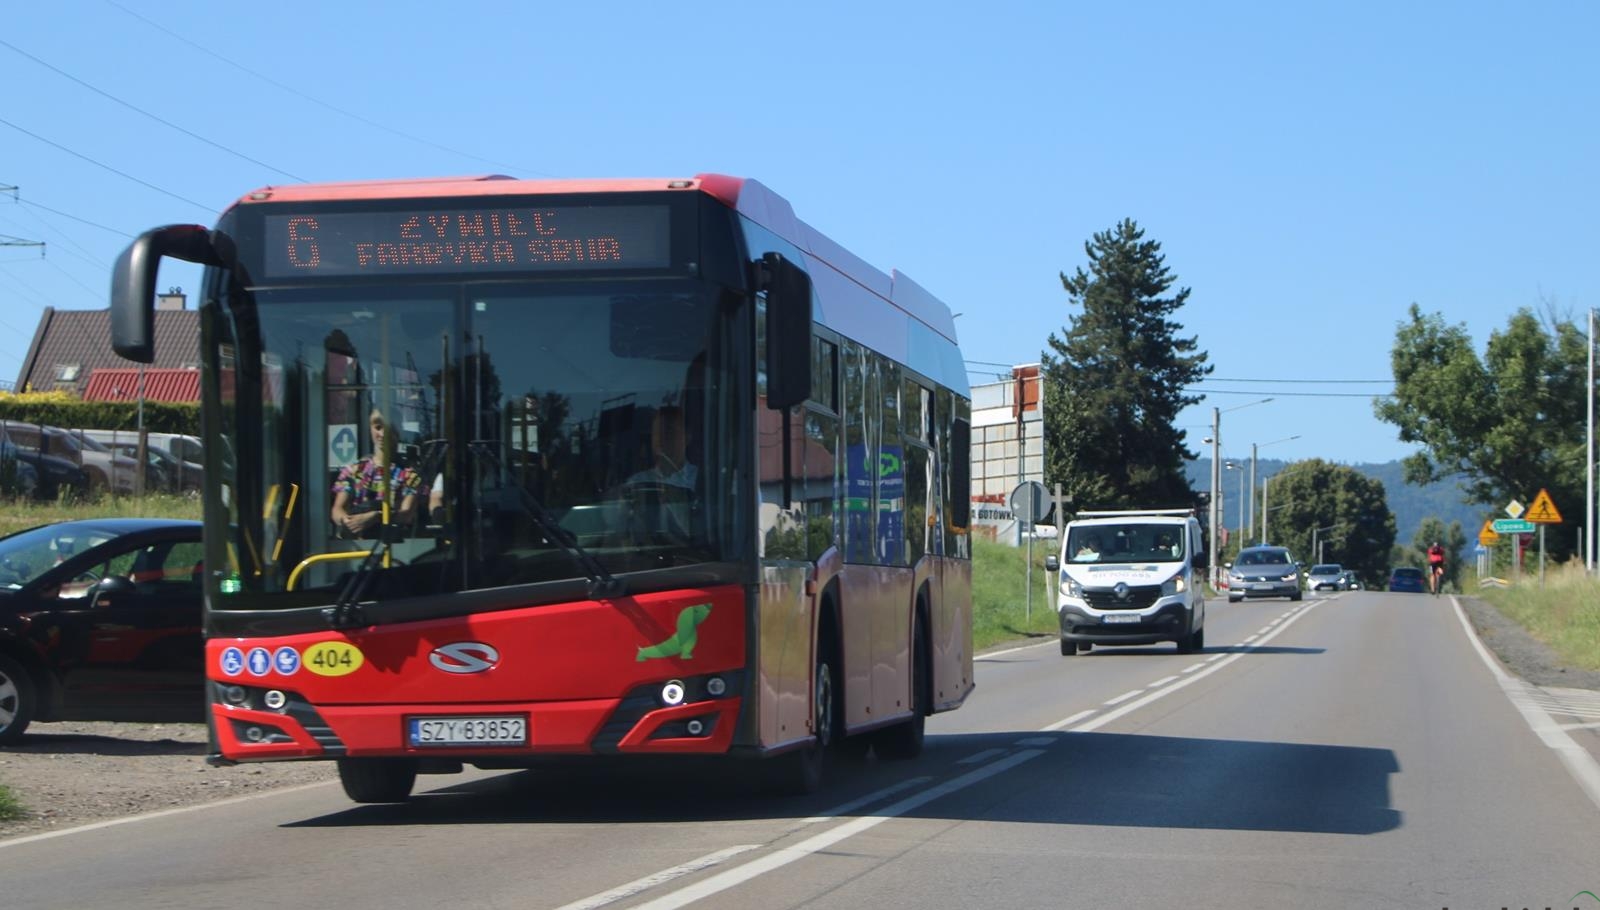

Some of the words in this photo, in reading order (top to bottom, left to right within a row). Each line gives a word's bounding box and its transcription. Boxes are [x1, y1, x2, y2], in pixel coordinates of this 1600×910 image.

[287, 215, 320, 268] 6
[312, 648, 352, 668] 404
[422, 721, 457, 741] SZY
[464, 719, 523, 740] 83852
